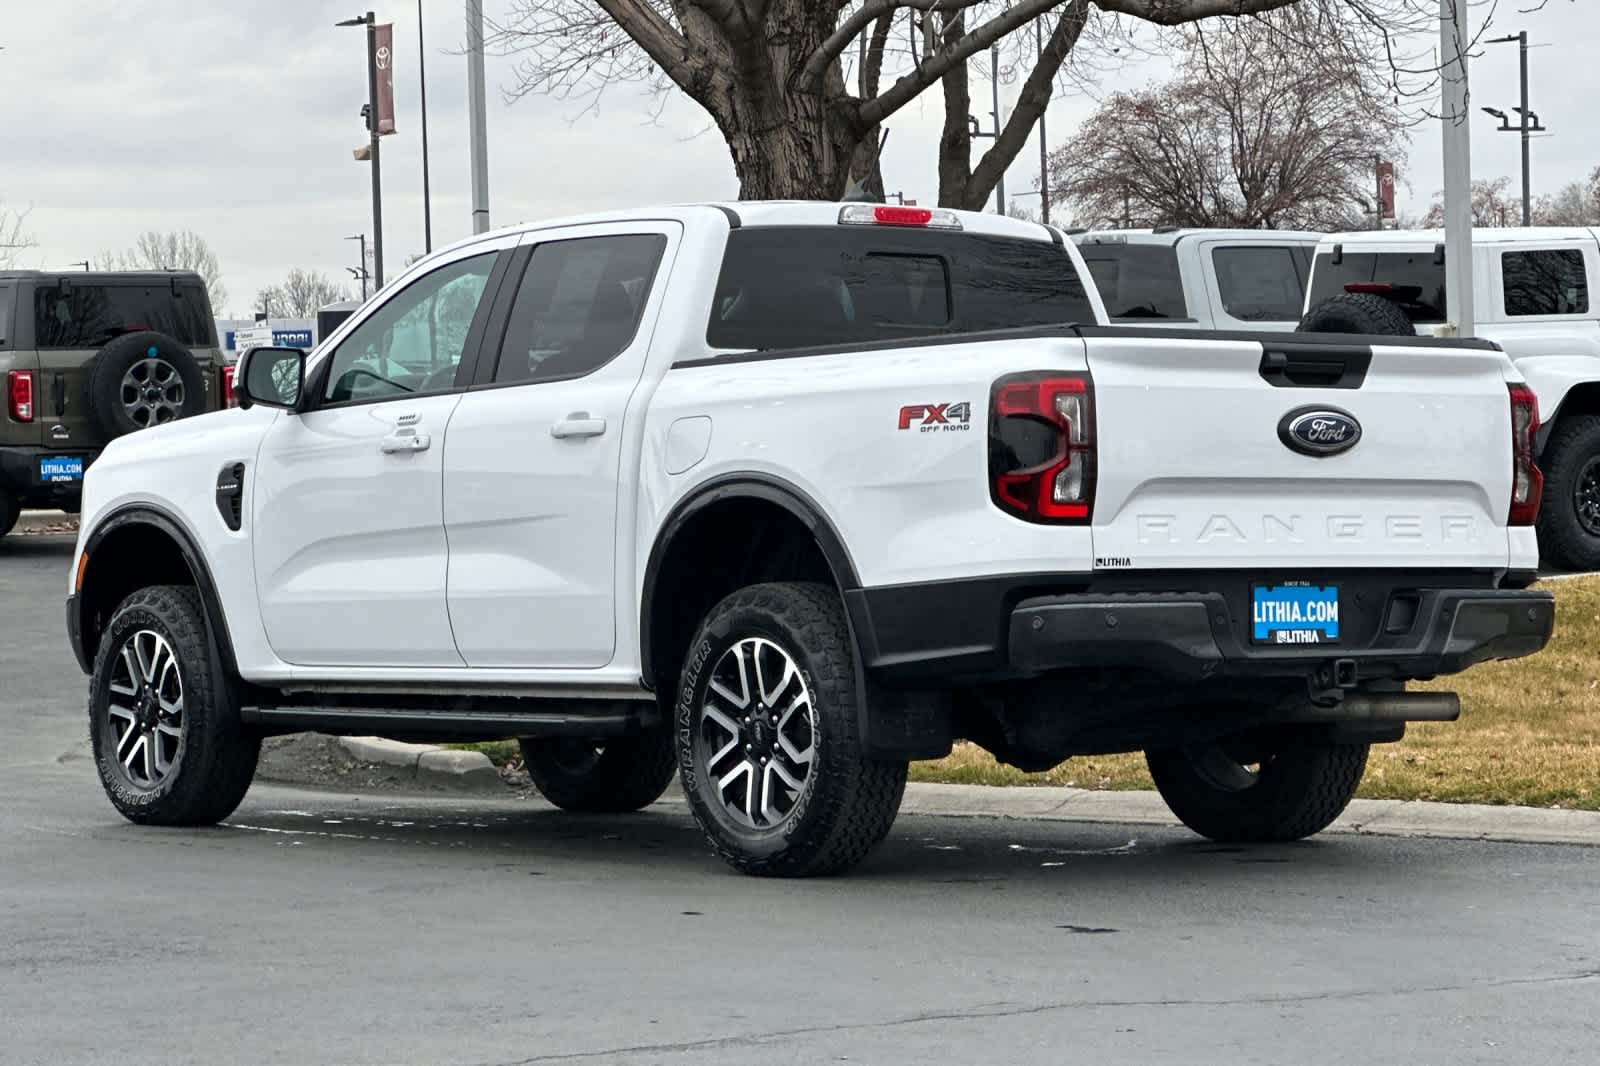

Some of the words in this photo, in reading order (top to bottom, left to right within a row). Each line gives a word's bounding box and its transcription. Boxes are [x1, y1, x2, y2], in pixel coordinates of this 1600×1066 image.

[898, 402, 970, 430] FX4
[1308, 419, 1346, 440] Ford
[41, 464, 82, 474] LITHIA.COM
[1136, 513, 1476, 544] RANGER
[1104, 557, 1131, 566] LITHIA
[1254, 600, 1338, 623] LITHIA.COM
[1286, 630, 1319, 643] LITHIA
[679, 639, 712, 792] WRANGLER
